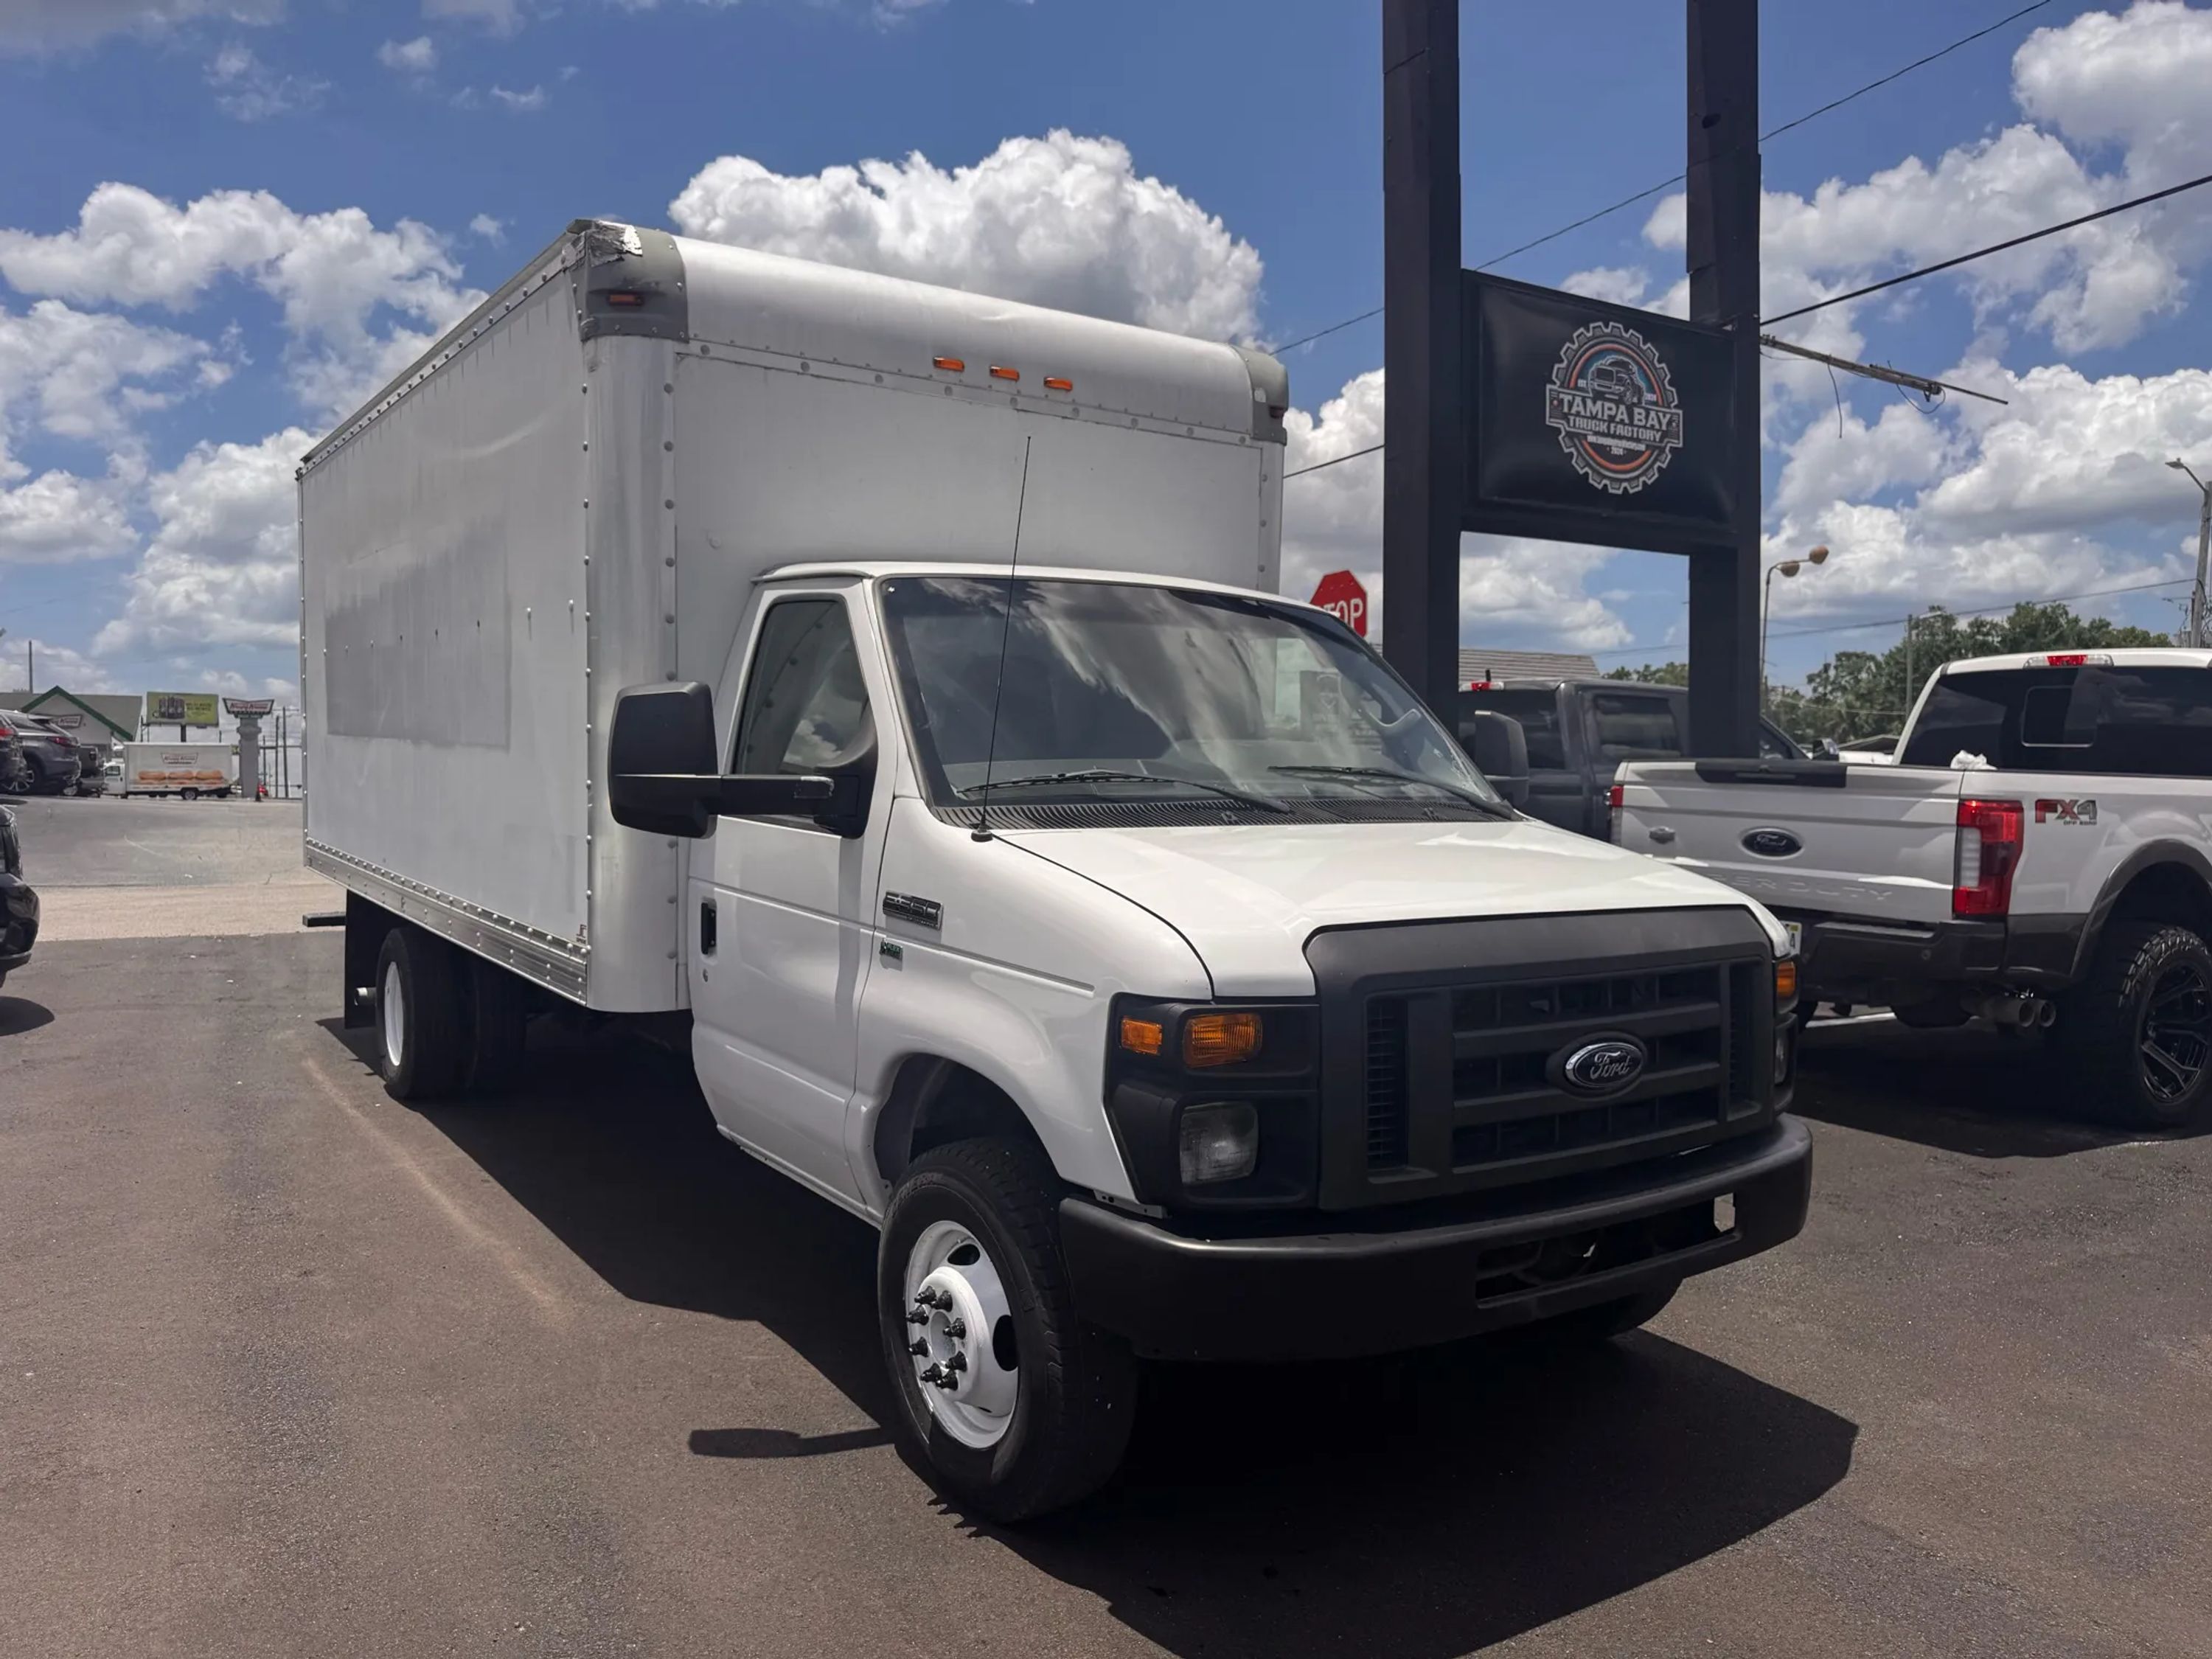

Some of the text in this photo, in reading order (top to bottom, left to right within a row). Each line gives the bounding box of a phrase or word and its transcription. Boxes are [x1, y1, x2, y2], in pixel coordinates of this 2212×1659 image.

[1559, 393, 1672, 431] TAMPA BAY
[1568, 415, 1663, 442] TRUCK FACTORY
[1324, 598, 1363, 628] OP
[2035, 799, 2097, 823] FX4
[1590, 1050, 1631, 1079] Ford
